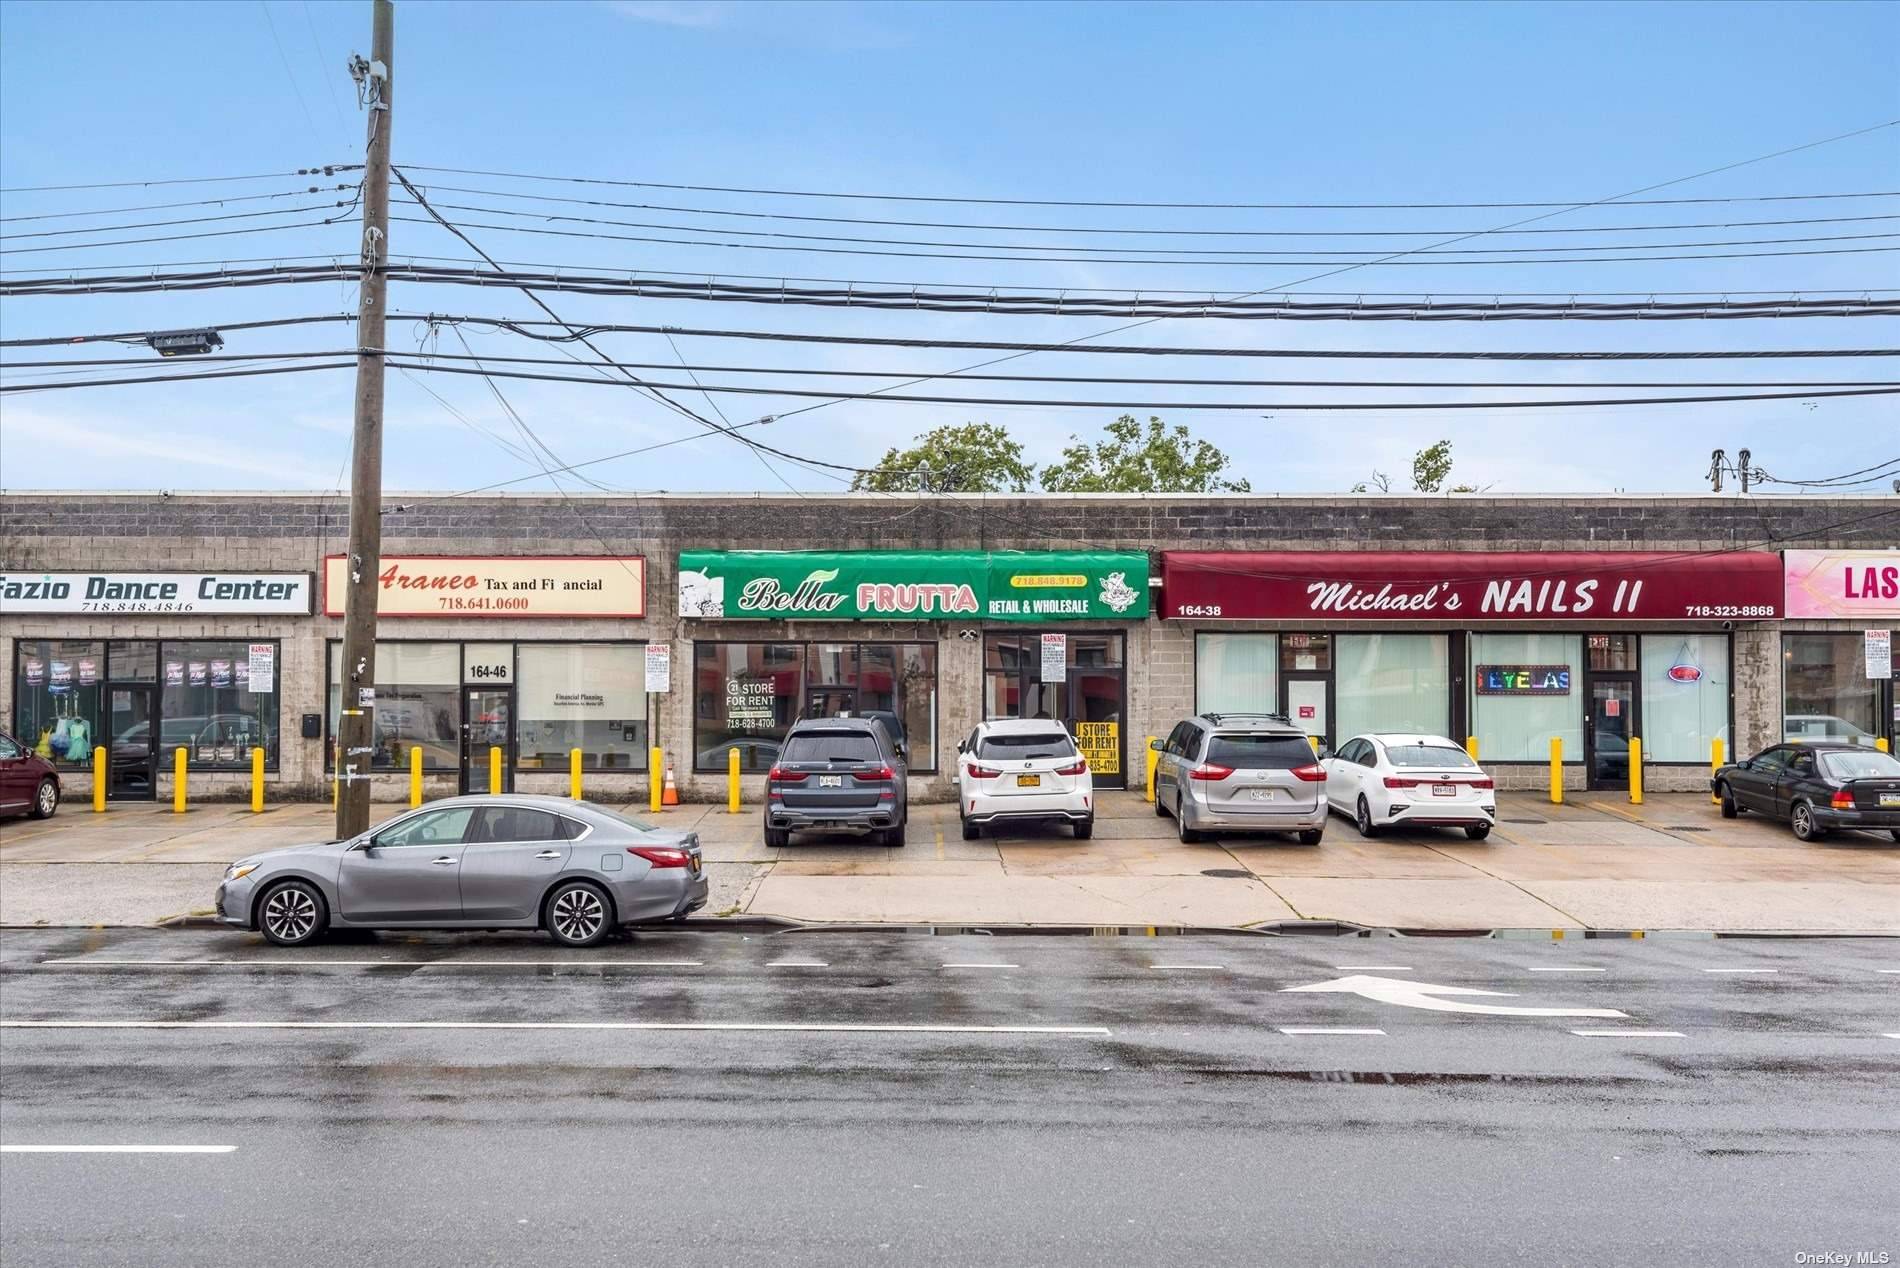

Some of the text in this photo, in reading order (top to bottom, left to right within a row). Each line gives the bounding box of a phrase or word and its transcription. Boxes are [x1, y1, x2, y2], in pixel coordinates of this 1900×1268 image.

[378, 564, 479, 590] Araneo
[484, 578, 508, 590] Tax
[512, 578, 537, 590] and
[1015, 576, 1083, 586] 718.848.9178
[85, 576, 178, 600] Dance
[198, 577, 299, 600] Center
[738, 577, 979, 613] Bella FRUTTA
[1307, 579, 1643, 613] Michael's NAILS II
[81, 602, 193, 611] 718.848.4846
[439, 597, 529, 609] 718.641.0600
[988, 599, 1089, 614] RETAIL & WHOLESALE
[1178, 604, 1222, 616] 164-38
[1686, 606, 1774, 616] 718-323-8868
[471, 665, 506, 678] 164-46
[742, 683, 774, 694] STORE
[580, 693, 604, 702] Planning
[726, 696, 775, 706] FOR RENT
[727, 718, 775, 728] 718-628-4700
[1082, 723, 1111, 737] STORE
[1077, 736, 1117, 749] FOR RENT
